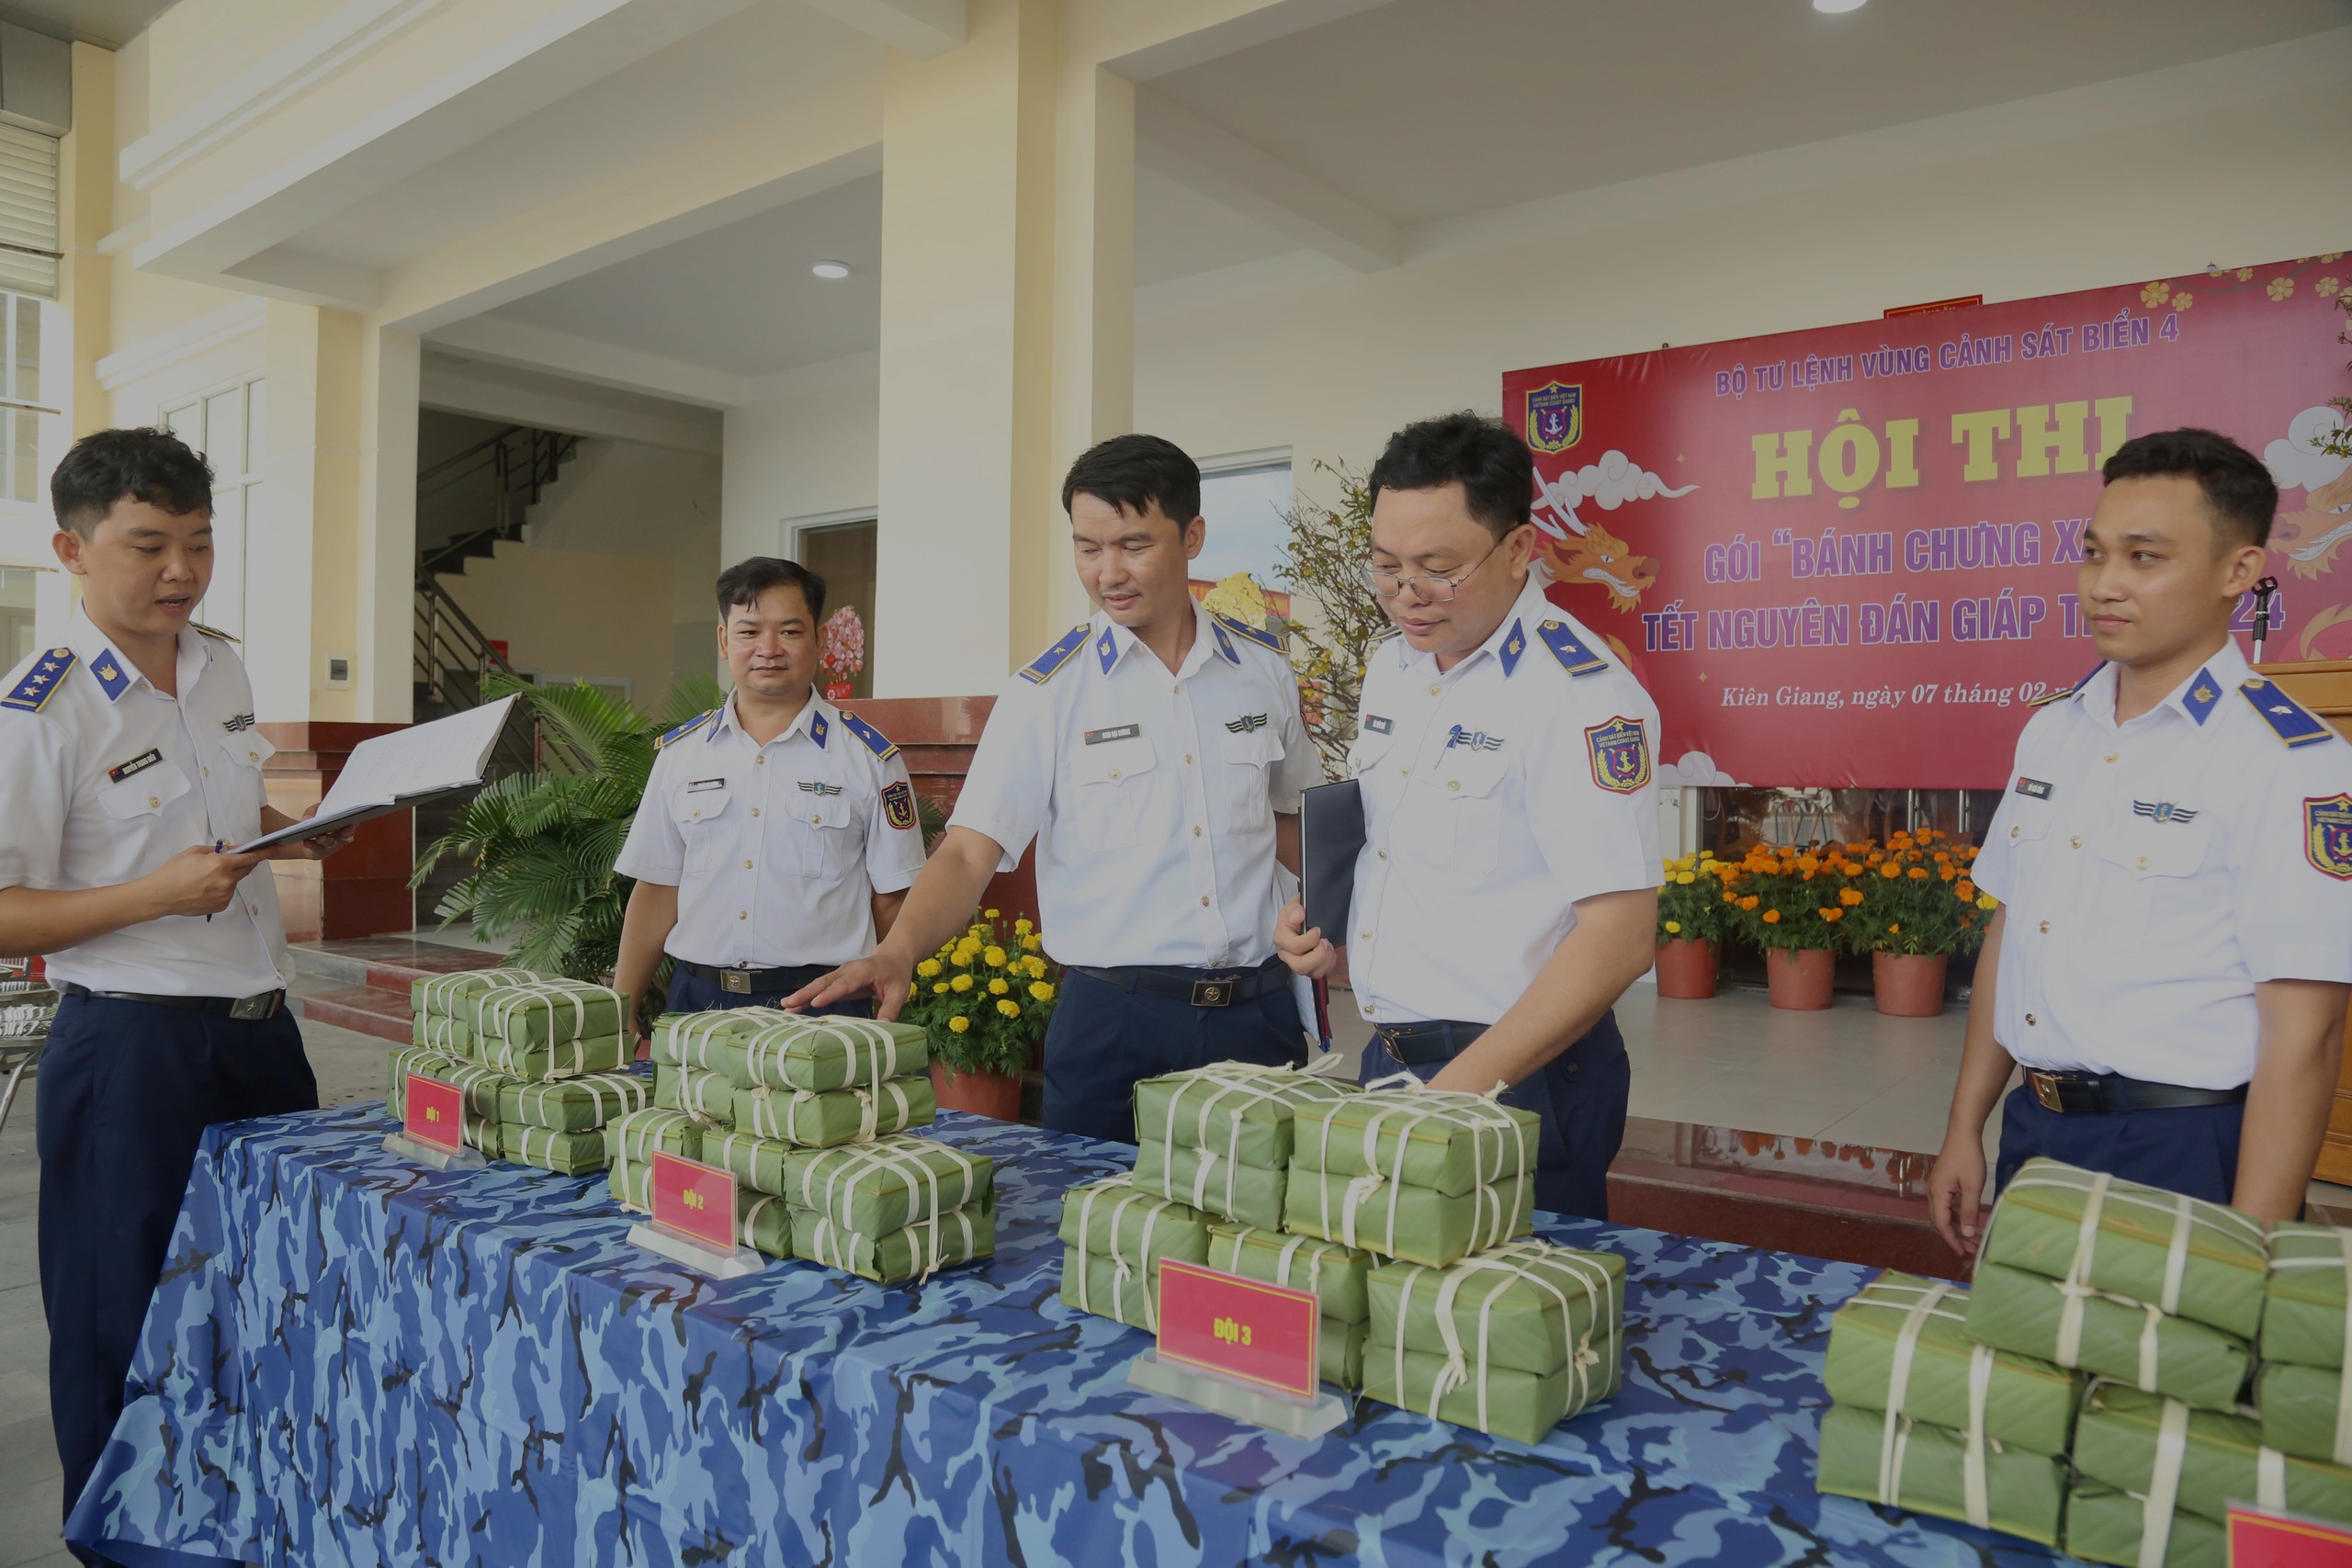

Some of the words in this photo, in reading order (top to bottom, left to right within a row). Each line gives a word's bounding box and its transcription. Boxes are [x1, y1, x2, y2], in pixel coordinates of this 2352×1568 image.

[1715, 363, 1747, 400] BỘ
[1754, 362, 1785, 392] TƯ
[1791, 354, 1853, 390] LỆNH
[1862, 344, 1929, 378] VÙNG
[1939, 333, 2012, 369] CẢNH
[2021, 323, 2073, 360] SÁT
[2083, 308, 2150, 353] BIỂN
[2160, 313, 2179, 343] 4
[1752, 408, 1918, 508] HỘI
[1951, 396, 2132, 482] THI
[1704, 534, 1761, 583] GÓI
[1905, 521, 2041, 572] CHƯNG
[1642, 599, 1699, 652] TẾT
[1708, 597, 1849, 650] NGUYÊN
[1860, 592, 1939, 645] ĐÁN
[1951, 588, 2047, 641] GIÁP
[2228, 588, 2286, 632] 24
[1721, 687, 1770, 706] Kiên
[1776, 685, 1845, 710] Giang,
[1850, 684, 1906, 709] ngày
[1911, 684, 1939, 704] 07
[1944, 682, 2014, 707] tháng
[2019, 682, 2047, 703] 02
[697, 1194, 704, 1210] 2
[1214, 1316, 1238, 1345] ĐỘI
[1241, 1325, 1251, 1346] 3
